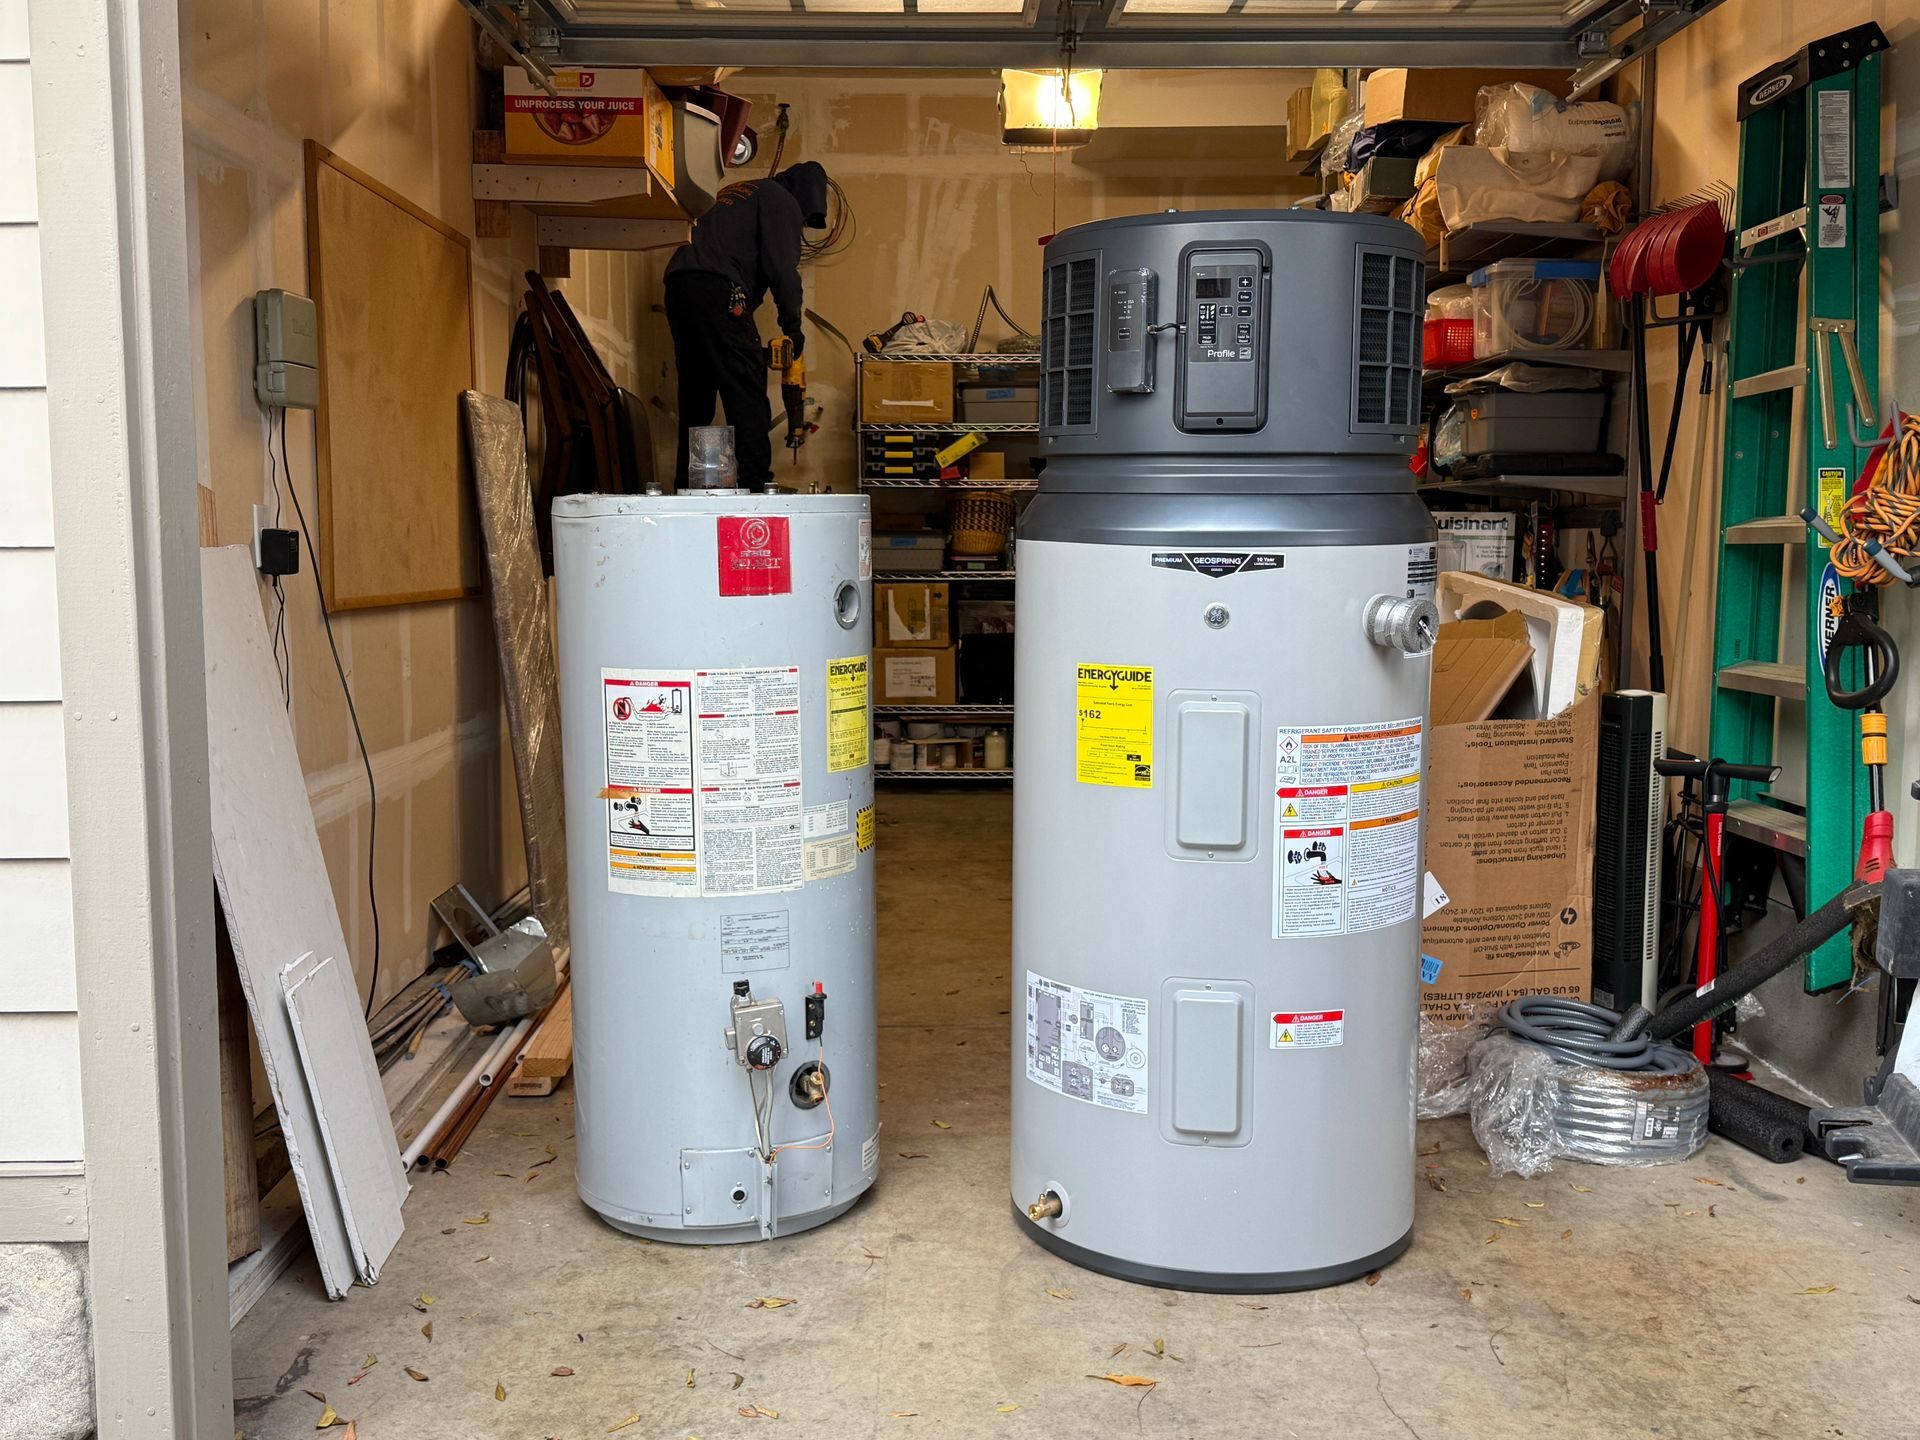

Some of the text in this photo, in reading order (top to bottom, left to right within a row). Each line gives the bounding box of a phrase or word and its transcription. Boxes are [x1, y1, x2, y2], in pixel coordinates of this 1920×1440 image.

[1759, 79, 1785, 100] WERNER
[514, 99, 635, 110] UNPROCESS YOUR JUICE
[1207, 350, 1235, 358] Profile
[1078, 668, 1152, 683] ENERGYGUIDE
[1078, 709, 1101, 719] $162
[1494, 730, 1525, 738] Measuring
[1494, 738, 1539, 746] Installation
[1540, 736, 1574, 744] Standard
[1279, 756, 1296, 764] A2L
[1526, 753, 1555, 761] Insulation
[1539, 760, 1569, 768] Expansion
[1515, 777, 1571, 786] Recommended
[1450, 806, 1485, 814] packaging
[1553, 810, 1562, 818] Pull
[1476, 815, 1491, 823] from
[1510, 812, 1529, 820] sleeve
[1471, 832, 1495, 840] vertical
[1496, 830, 1518, 838] dashed
[1477, 852, 1566, 865] Unpacking Instructions:
[1463, 921, 1526, 931] Options/Options
[1422, 937, 1464, 945] automatique
[1496, 949, 1550, 959] Wireless/Sans
[1424, 985, 1580, 1001] 65 US GAL (54.1 IMP/246 LITRES)
[1300, 1014, 1324, 1022] DANGER
